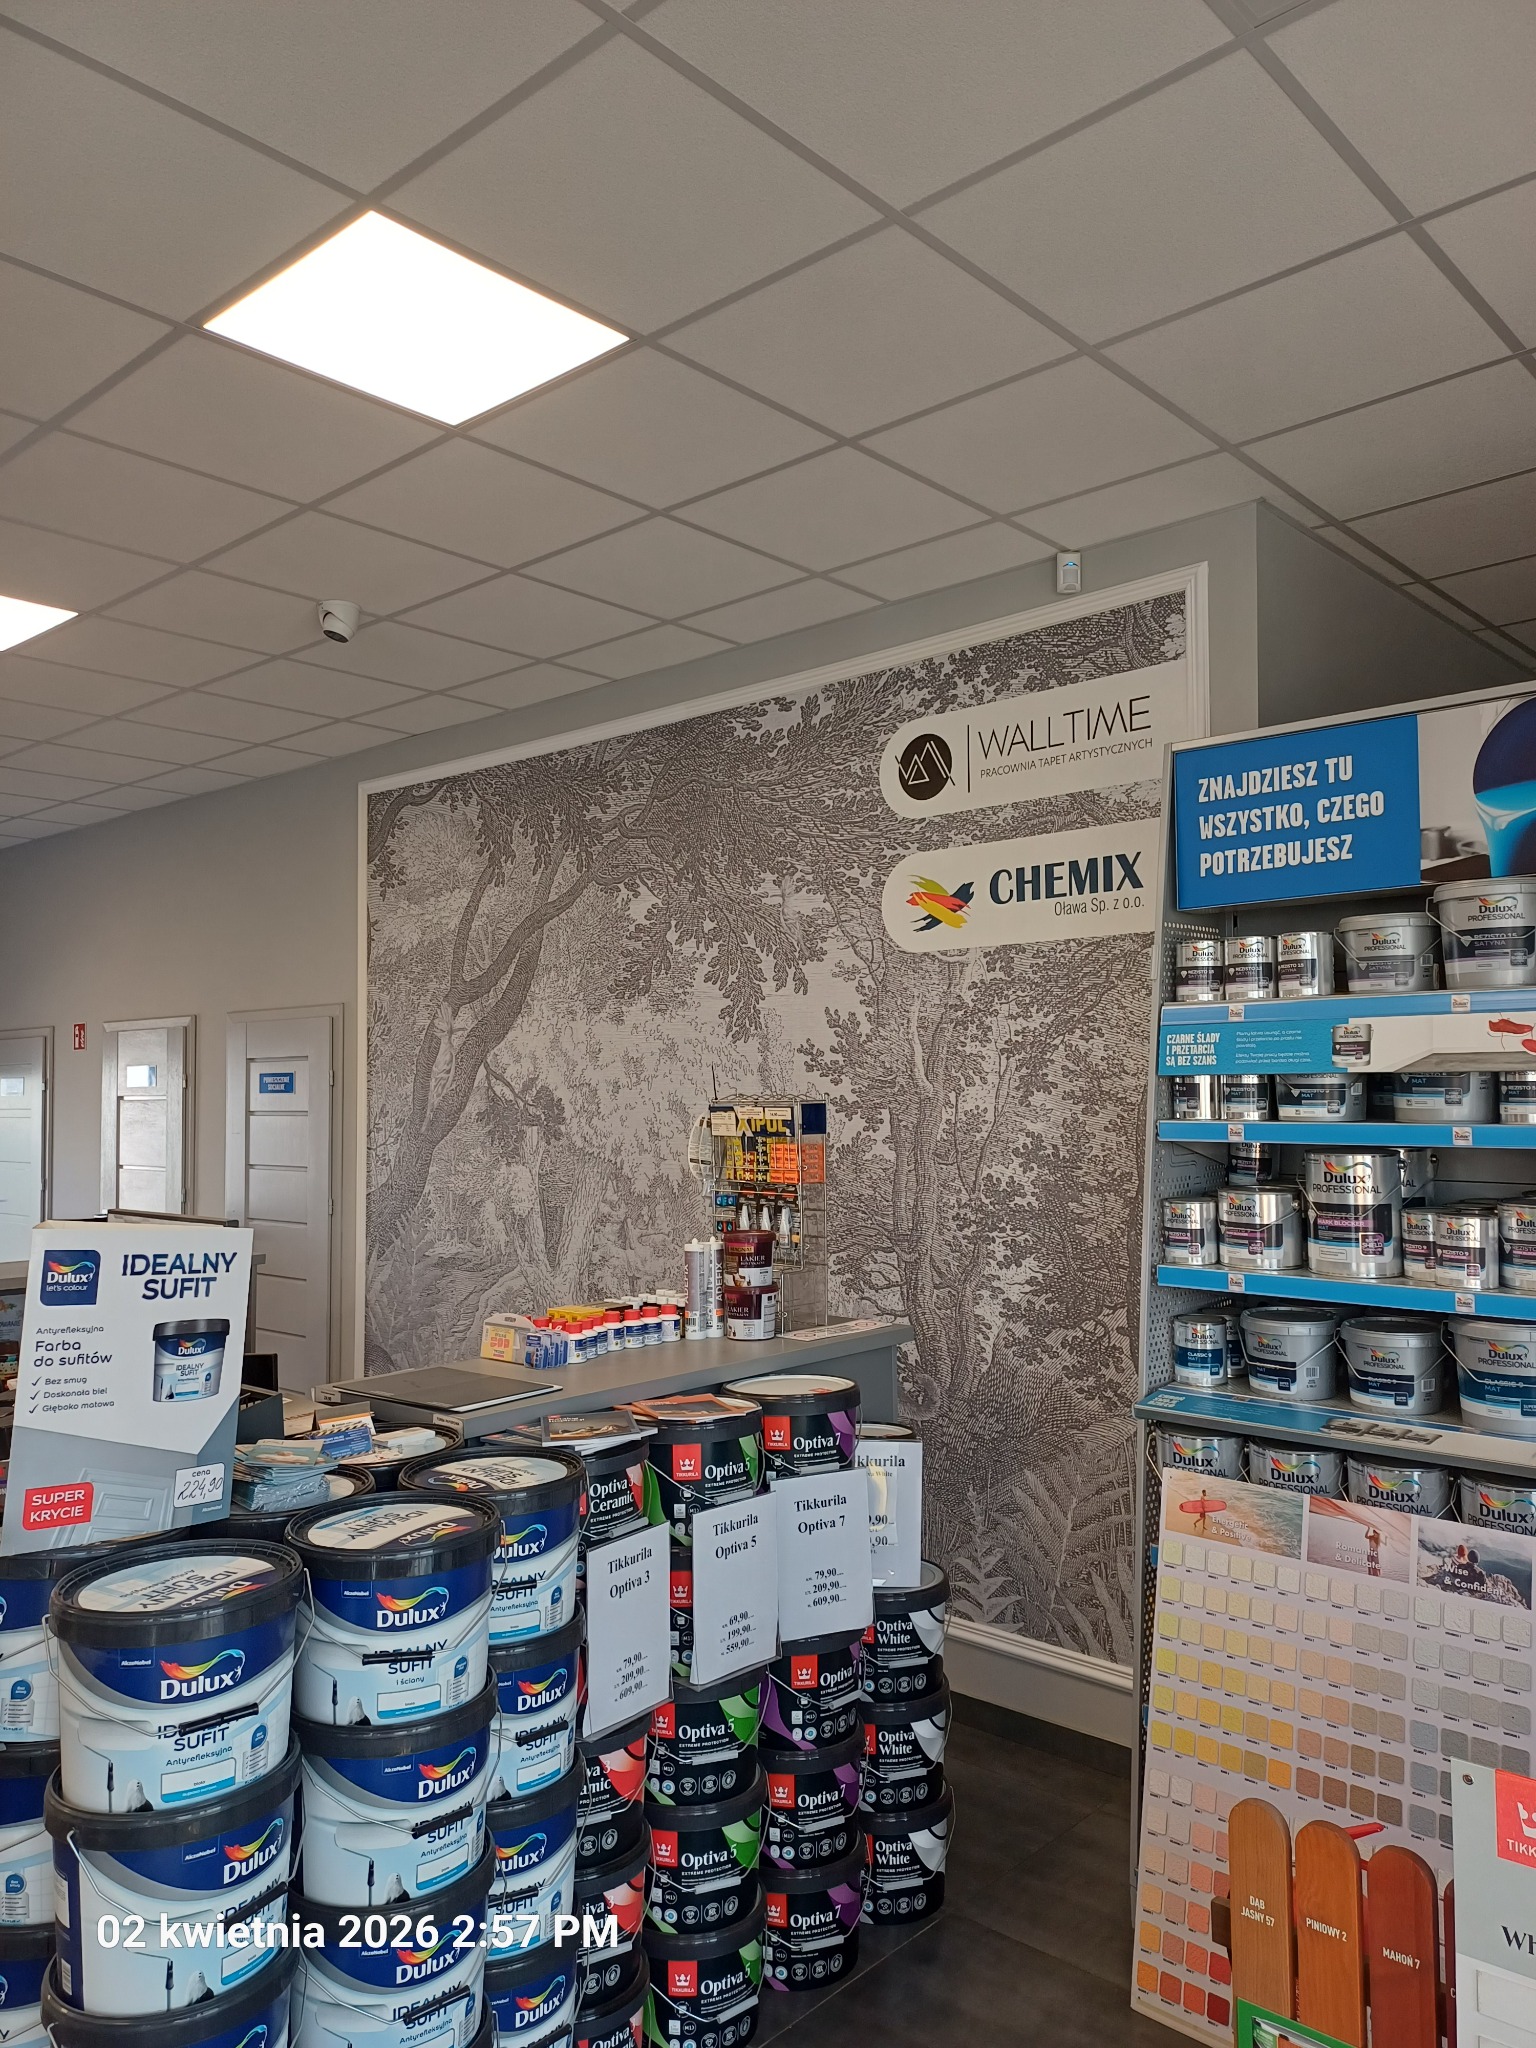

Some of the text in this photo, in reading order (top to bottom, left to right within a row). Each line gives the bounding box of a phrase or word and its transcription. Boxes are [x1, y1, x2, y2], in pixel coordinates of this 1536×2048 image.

[978, 695, 1151, 760] WALLTIME
[980, 738, 1153, 778] PRACOWNIA TAPET ARTYSTYCZNYCH
[1198, 755, 1353, 803] ZNAJDZIESZ TU
[1199, 790, 1385, 840] WSZYSTKO, CZEGO
[1199, 833, 1353, 878] POTRZEBUJESZ
[989, 851, 1144, 905] CHEMIX
[1054, 901, 1087, 916] Oława
[1090, 897, 1109, 915] Sp.
[1123, 897, 1145, 909] o.o.
[1479, 904, 1514, 914] Dulux
[1467, 912, 1525, 923] PROFESSIONAL
[1282, 943, 1304, 951] Dulux
[1372, 937, 1397, 946] Dulux
[1474, 939, 1506, 947] SATYNA
[1192, 949, 1215, 958] Dulux
[1240, 946, 1262, 955] Dulux
[1166, 1031, 1220, 1044] CZARNE ŚLADY
[1166, 1044, 1215, 1055] I PRZETARCIA
[1166, 1055, 1217, 1068] SĄ BEZ SZANS
[1324, 1172, 1366, 1184] Dulux
[1313, 1183, 1382, 1195] PROFESSIONAL
[1229, 1203, 1252, 1211] Dulux
[1447, 1228, 1470, 1236] Dulux
[121, 1252, 238, 1277] IDEALNY
[47, 1272, 88, 1284] Dulux
[141, 1277, 217, 1300] SUFIT
[36, 1326, 104, 1335] Antyrefleksyjna
[35, 1340, 81, 1352] Farba
[178, 1346, 201, 1355] Dulux
[1258, 1342, 1279, 1350] Dulux
[34, 1351, 112, 1367] do sufitów
[1371, 1354, 1395, 1363] Dulux
[1488, 1349, 1523, 1361] Dulux
[176, 1363, 204, 1371] IDEALNY
[1363, 1360, 1405, 1370] PROFESSIONAL
[44, 1390, 90, 1398] Doskonała
[42, 1403, 79, 1413] Głęboko
[793, 1432, 841, 1453] Optiva 7
[1173, 1452, 1213, 1467] Dulux
[192, 1469, 210, 1477] cena
[704, 1457, 750, 1482] Optiva 5
[1271, 1468, 1314, 1484] Dulux
[177, 1477, 223, 1500] 224,90
[590, 1479, 628, 1499] Optiva
[1369, 1485, 1415, 1503] Dulux
[31, 1489, 85, 1506] SUPER
[590, 1490, 635, 1513] Ceramic
[794, 1494, 847, 1512] Tikkurila
[29, 1505, 84, 1523] KRYCIE
[1480, 1503, 1529, 1523] Dulux
[404, 1521, 458, 1541] Dulux
[713, 1513, 759, 1536] Tikkurila
[798, 1515, 845, 1535] Optiva 7
[1212, 1516, 1249, 1530] Energetic
[1211, 1526, 1251, 1542] & Positive
[715, 1535, 757, 1560] Optiva 5
[1336, 1541, 1378, 1557] Romantic
[607, 1547, 653, 1575] Tikkurila
[1335, 1553, 1381, 1570] & Delicate
[1442, 1563, 1469, 1576] Wise
[815, 1567, 837, 1580] 79,90
[610, 1570, 650, 1599] Optiva 3
[812, 1580, 840, 1594] 209,90
[1444, 1576, 1503, 1595] & Confident
[490, 1600, 538, 1612] Antyrefleksyjna
[812, 1594, 840, 1608] 609,90
[377, 1606, 440, 1628] Dulux
[729, 1610, 749, 1626] 69,90
[727, 1624, 751, 1641] 199,90
[877, 1619, 913, 1635] Optiva
[726, 1637, 749, 1655] 559,90
[877, 1633, 911, 1645] White
[623, 1652, 642, 1669] 79,90
[401, 1676, 424, 1686] ściany
[621, 1665, 644, 1685] 209,90
[820, 1667, 853, 1688] Optiva
[161, 1672, 234, 1700] Dulux
[619, 1680, 643, 1701] 609,90
[517, 1686, 562, 1711] Dulux
[174, 1727, 229, 1751] SUFIT
[678, 1718, 735, 1743] Optiva 5
[878, 1731, 915, 1744] Optiva
[166, 1746, 232, 1766] Antyrefleksyjna
[879, 1743, 912, 1756] White
[603, 1760, 611, 1775] 3
[418, 1768, 470, 1799] Dulux
[797, 1784, 846, 1809] Optiva 7
[421, 1833, 468, 1858] Antyrefleksyjna
[876, 1840, 912, 1855] Optiva
[223, 1843, 278, 1885] Dulux
[681, 1843, 738, 1870] Optiva 5
[876, 1854, 910, 1866] White
[1250, 1895, 1265, 1910] DĄB
[790, 1904, 841, 1930] Optiva 7
[1241, 1906, 1275, 1928] JASNY 57
[1306, 1917, 1347, 1942] PINIOWY 2
[1382, 1947, 1420, 1970] MAHOŃ 7
[396, 1950, 455, 1985] Dulux
[700, 1962, 750, 1996] Optiva 5
[515, 1998, 561, 2029] Dulux
[400, 2018, 453, 2045] Antyrefleksyjna
